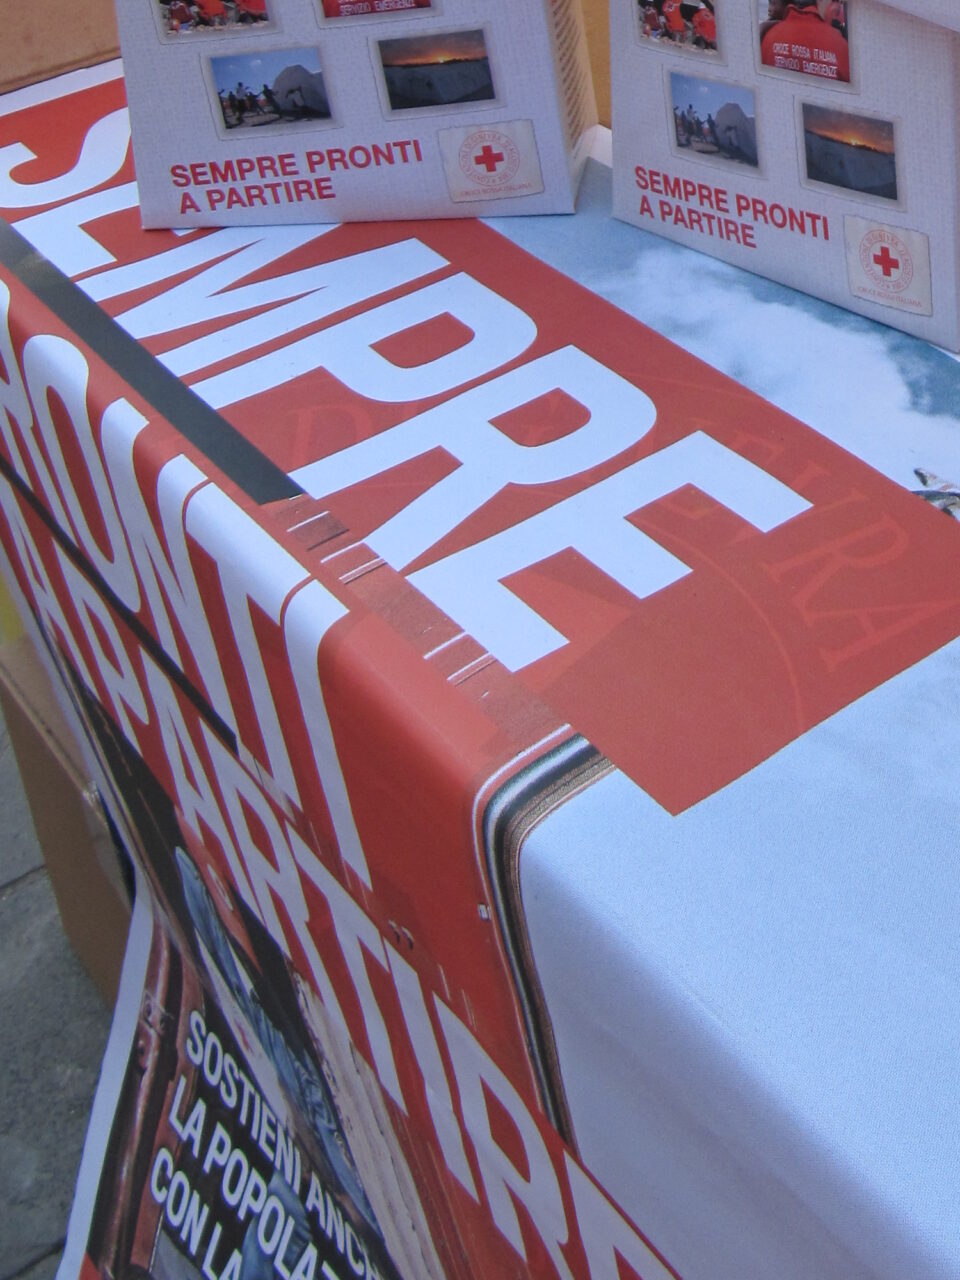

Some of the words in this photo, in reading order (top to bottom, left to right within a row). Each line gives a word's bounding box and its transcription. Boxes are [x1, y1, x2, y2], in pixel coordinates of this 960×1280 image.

[171, 154, 296, 187] SEMPRE
[306, 140, 421, 173] PRONTI
[180, 192, 199, 214] A
[207, 177, 335, 209] PARTIRE
[635, 166, 728, 211] SEMPRE
[736, 194, 828, 240] PRONTI
[640, 195, 653, 218] A
[659, 200, 755, 248] PARTIRE
[168, 1075, 206, 1159] LA
[186, 1010, 302, 1195] SOSTIENI
[150, 1147, 210, 1256] CON
